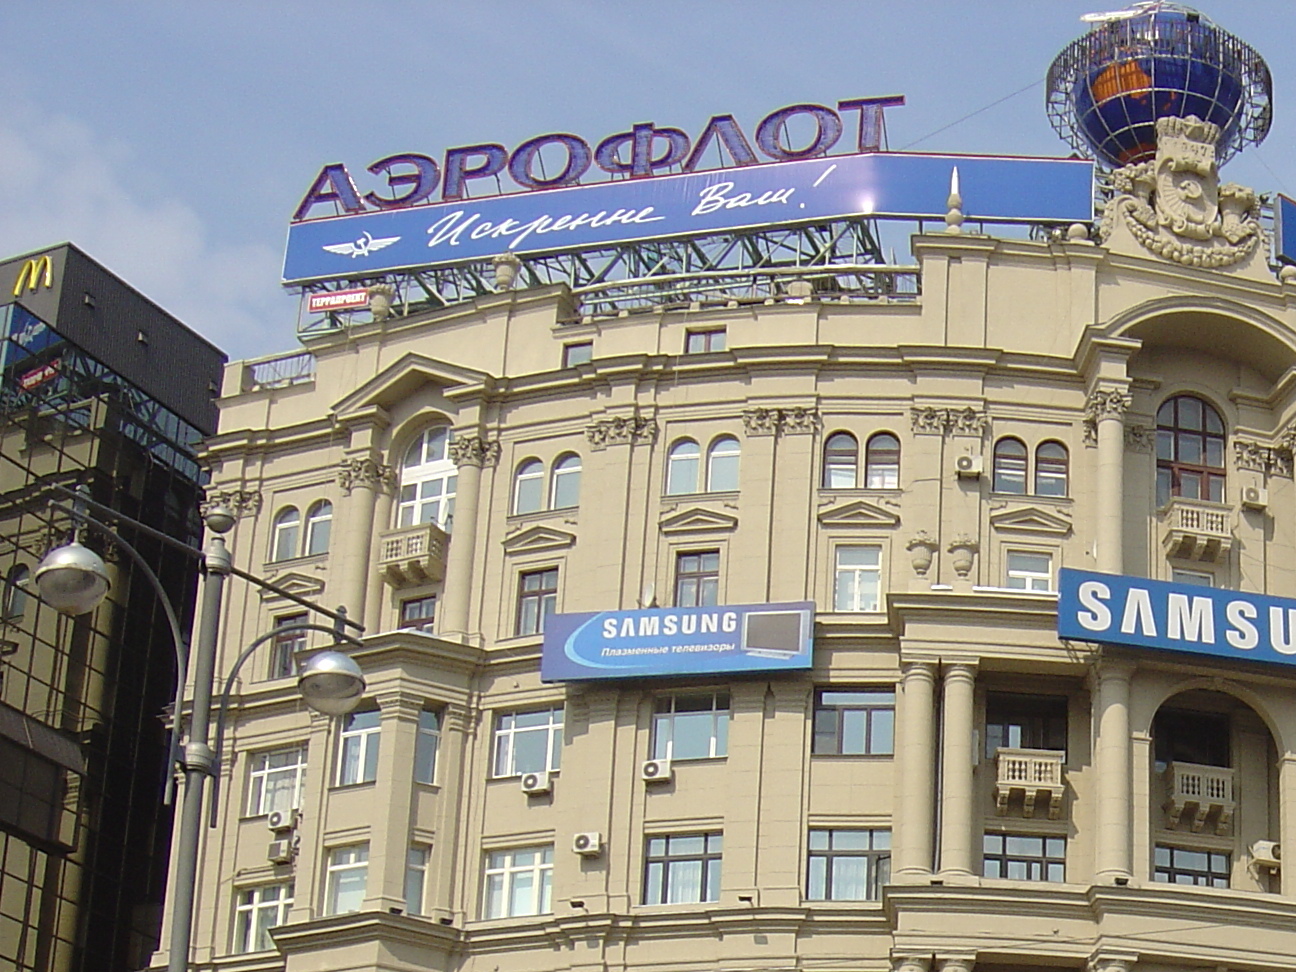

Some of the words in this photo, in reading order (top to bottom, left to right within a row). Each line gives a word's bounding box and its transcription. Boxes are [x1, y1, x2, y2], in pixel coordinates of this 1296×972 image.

[292, 96, 905, 219] АЭРОФЛОТ
[427, 204, 665, 248] Искренне
[602, 612, 737, 639] SAMSUNG
[601, 645, 668, 657] Плазменные
[671, 643, 735, 654] телевизоры
